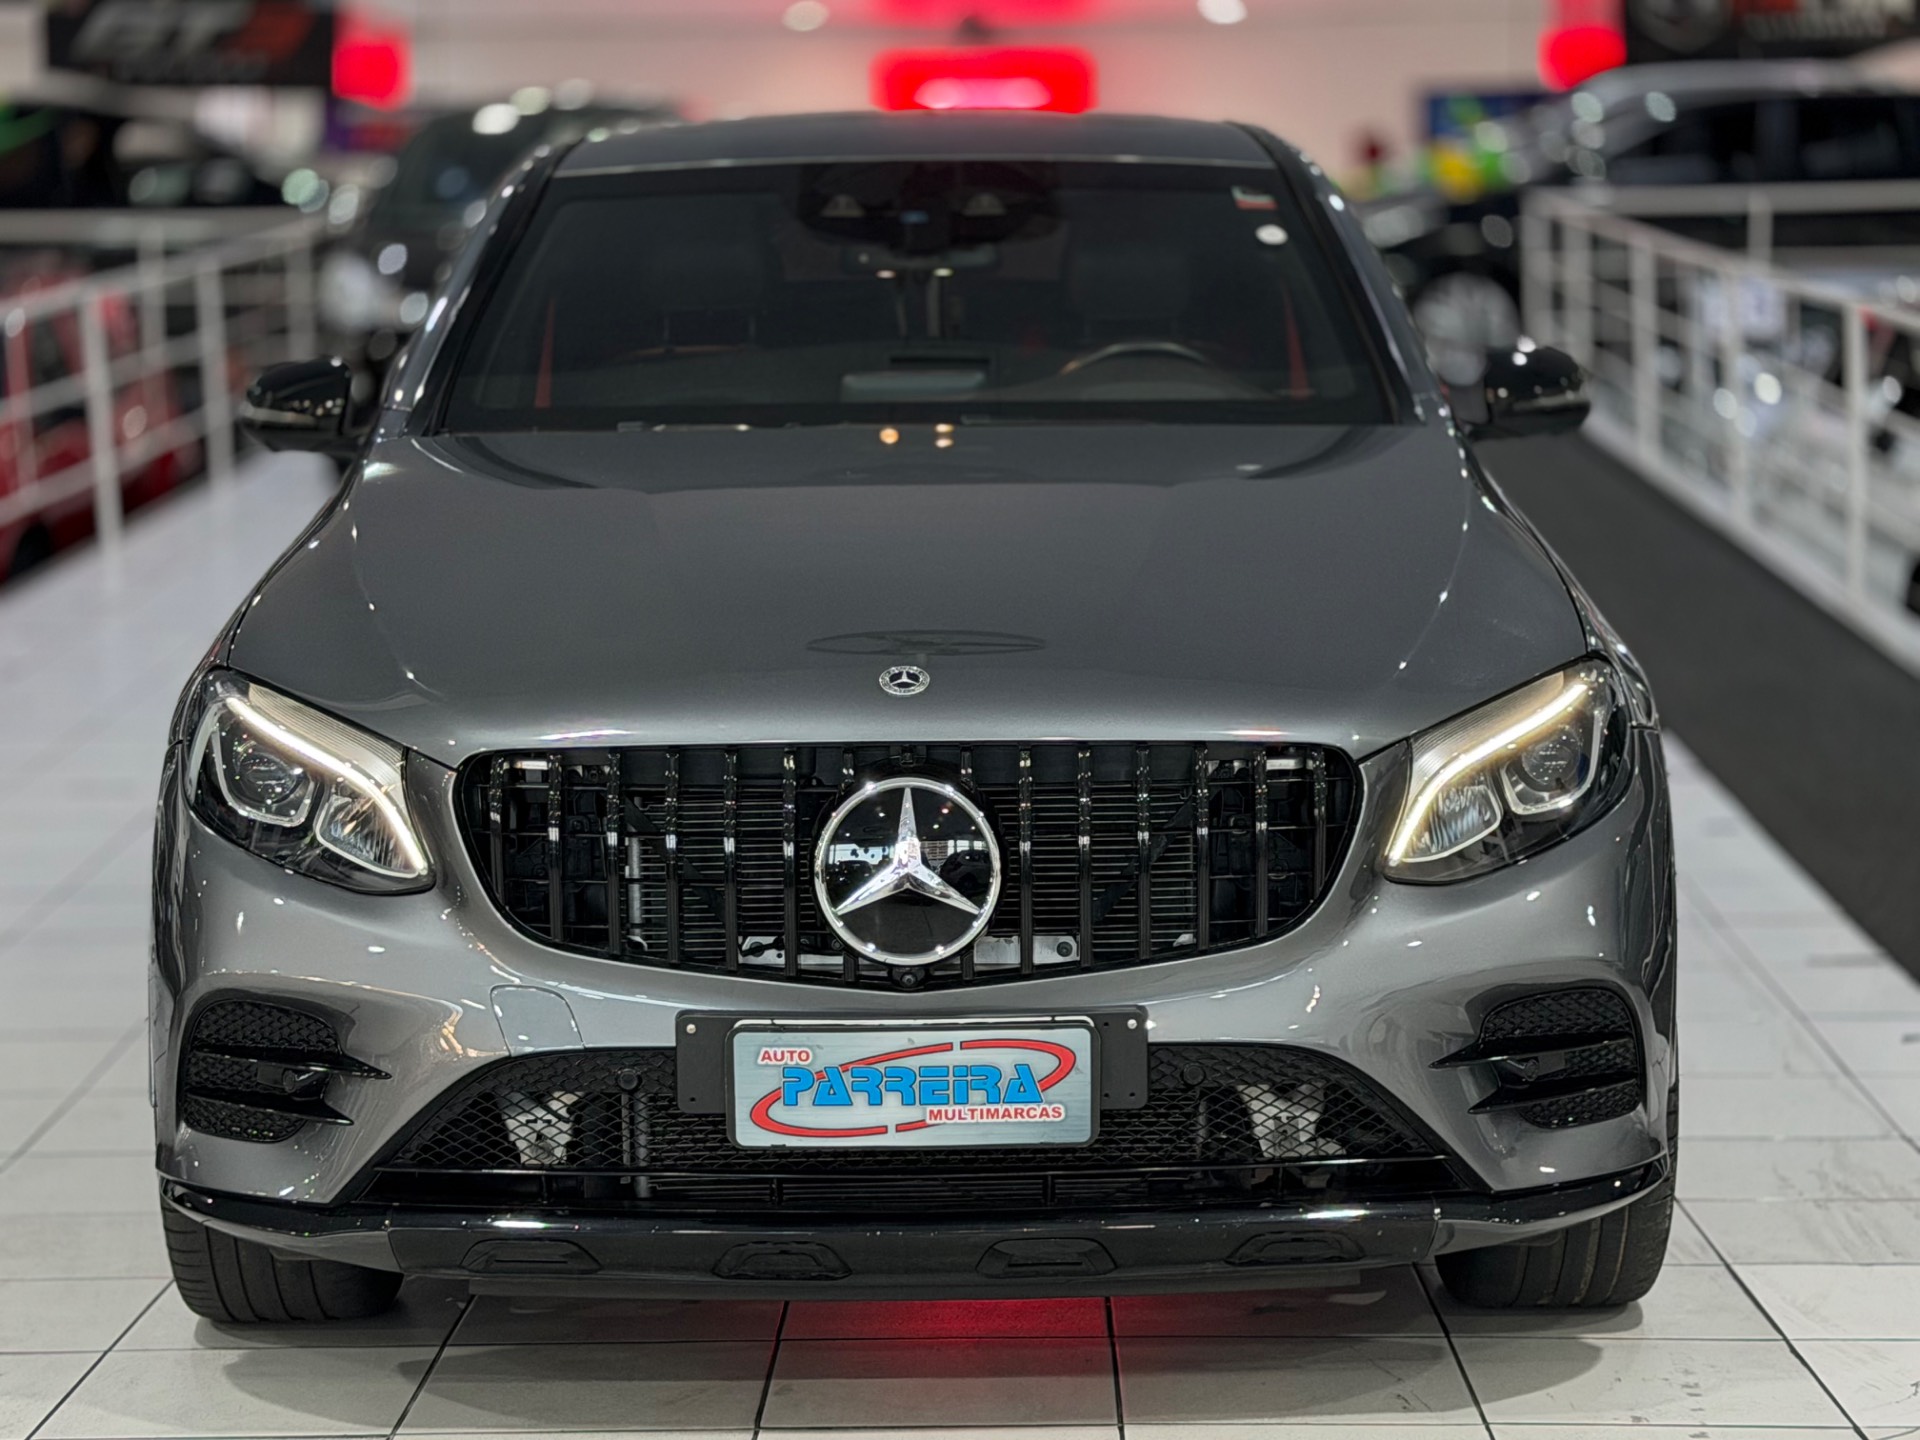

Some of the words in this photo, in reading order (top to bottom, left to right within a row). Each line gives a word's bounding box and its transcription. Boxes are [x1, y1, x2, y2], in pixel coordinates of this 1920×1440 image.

[760, 1049, 811, 1063] AUTO
[782, 1064, 1044, 1106] PARREIRA
[928, 1106, 1063, 1121] MULTIMARCAS
